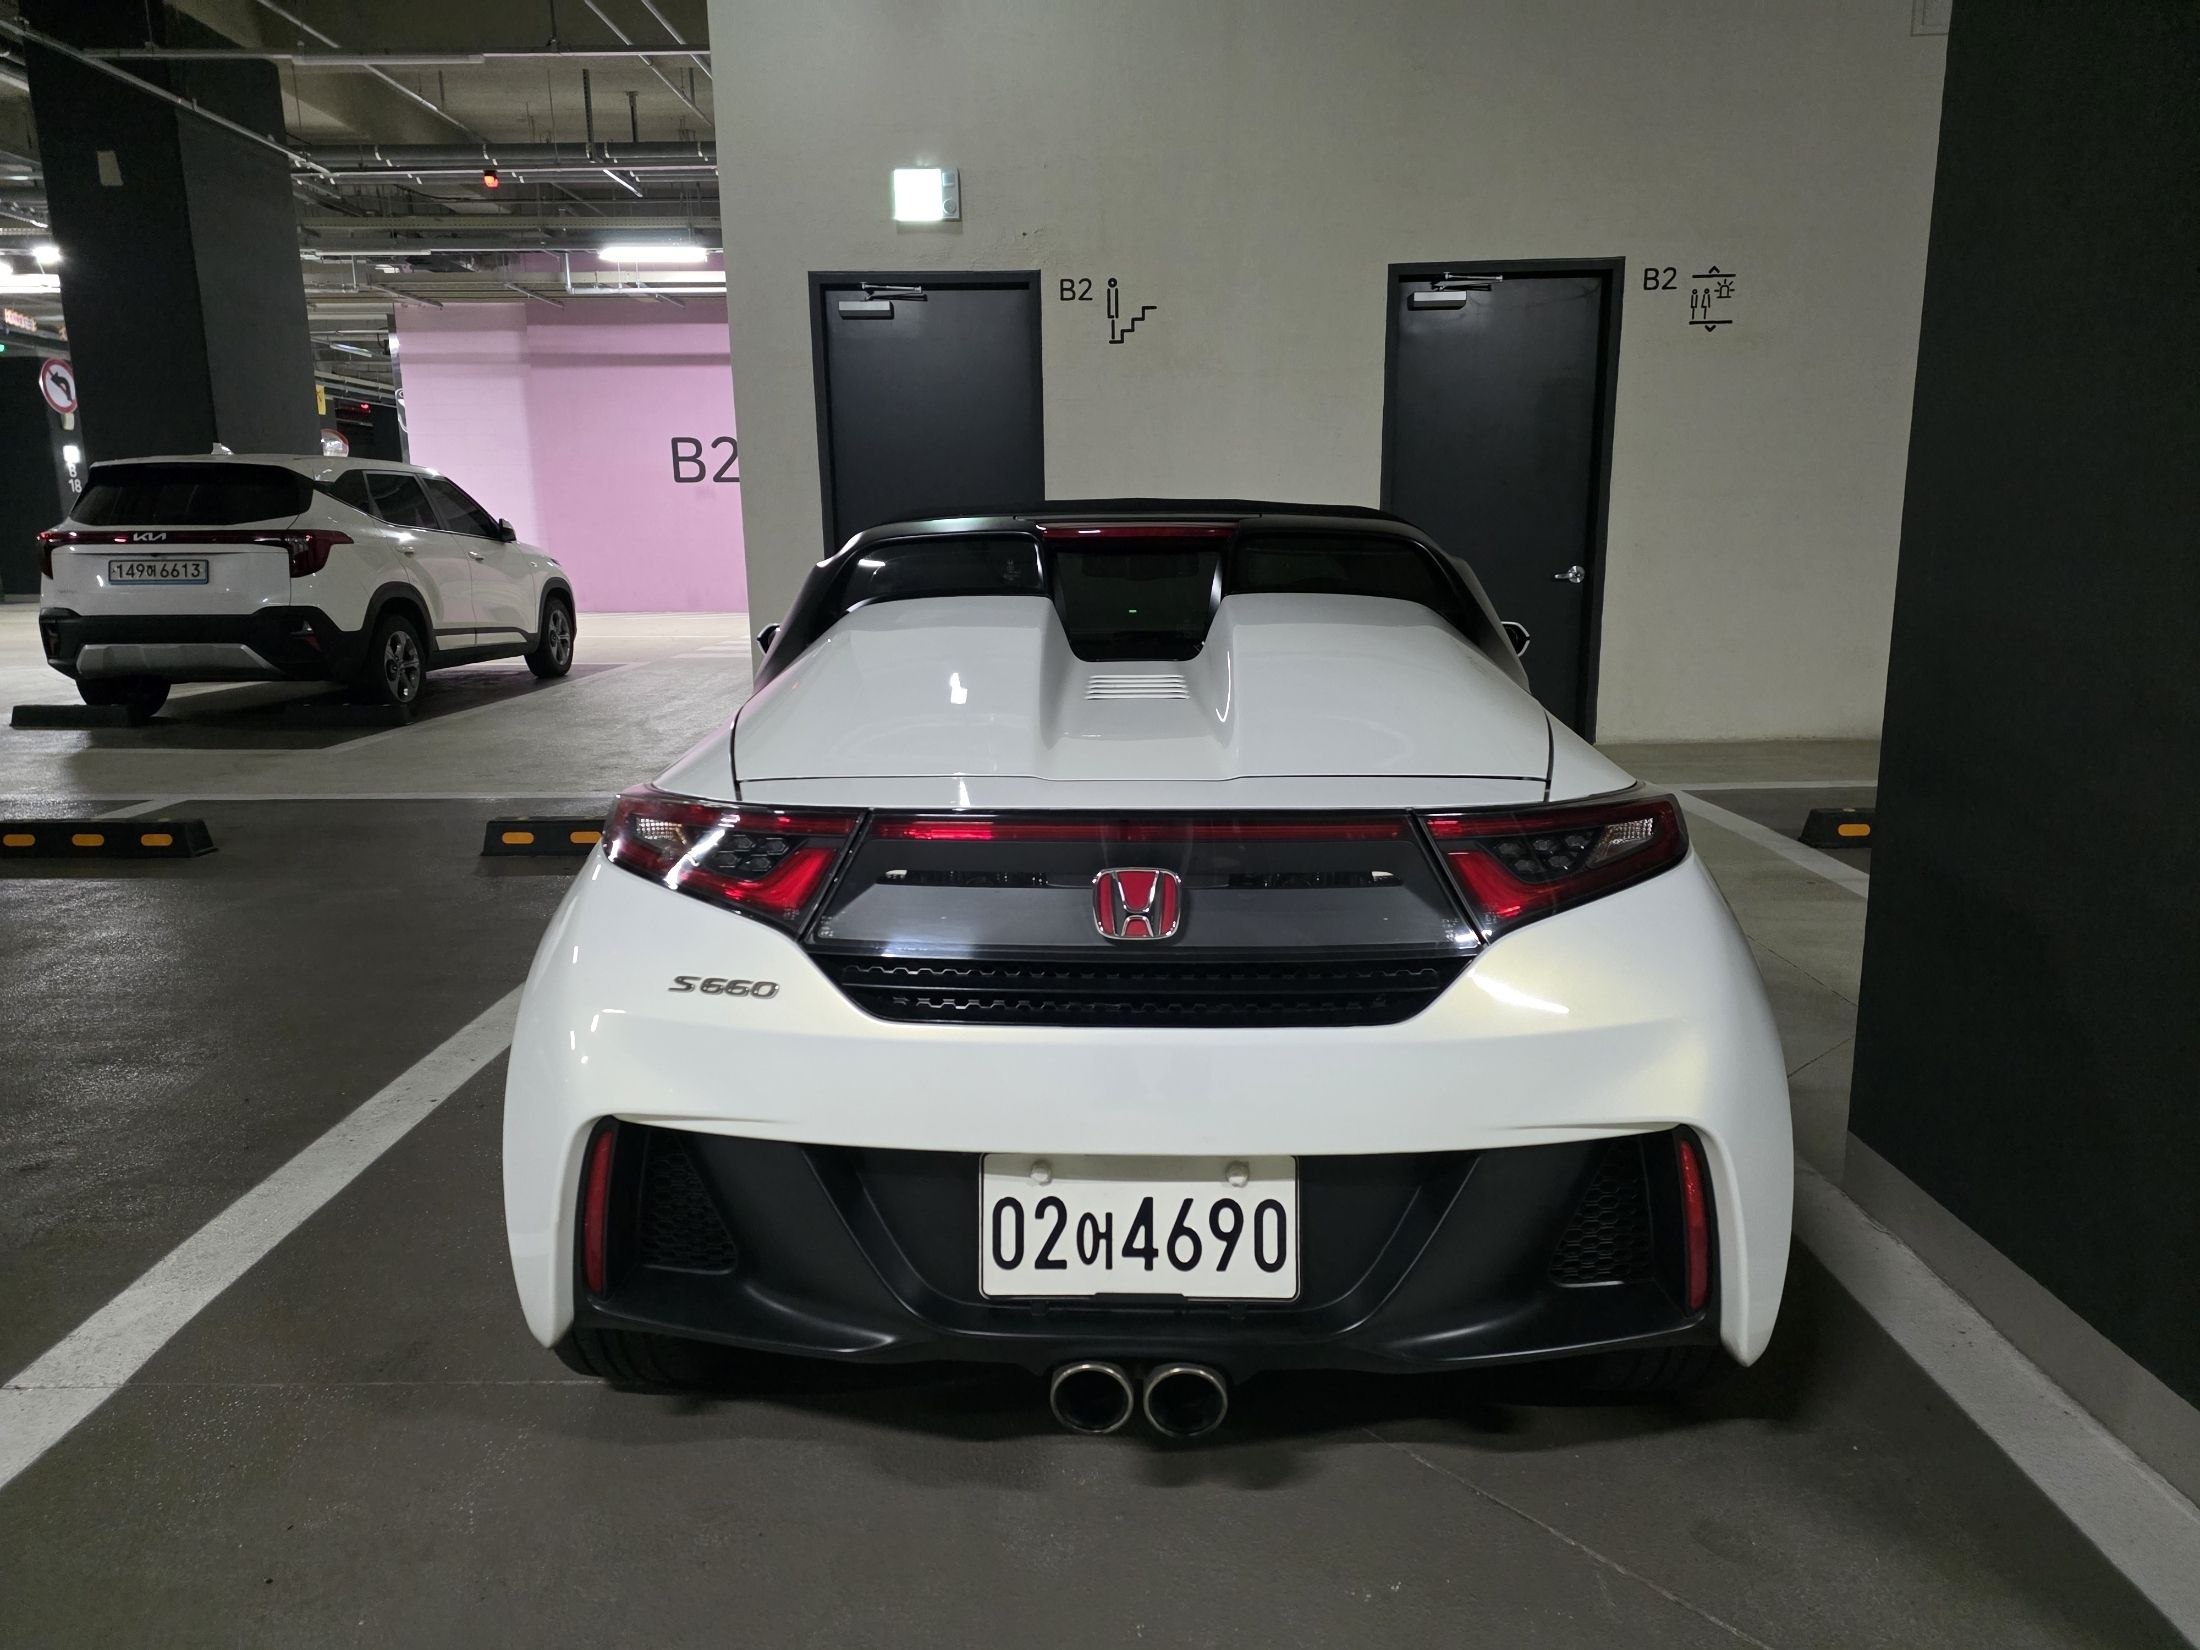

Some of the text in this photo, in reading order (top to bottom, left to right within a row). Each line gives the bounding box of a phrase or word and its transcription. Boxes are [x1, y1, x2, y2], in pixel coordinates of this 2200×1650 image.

[1060, 278, 1093, 301] B2
[1643, 267, 1677, 290] B2
[671, 436, 740, 483] B2
[68, 479, 83, 493] 18
[668, 975, 780, 1000] S660
[992, 1195, 1287, 1273] 02어4690
